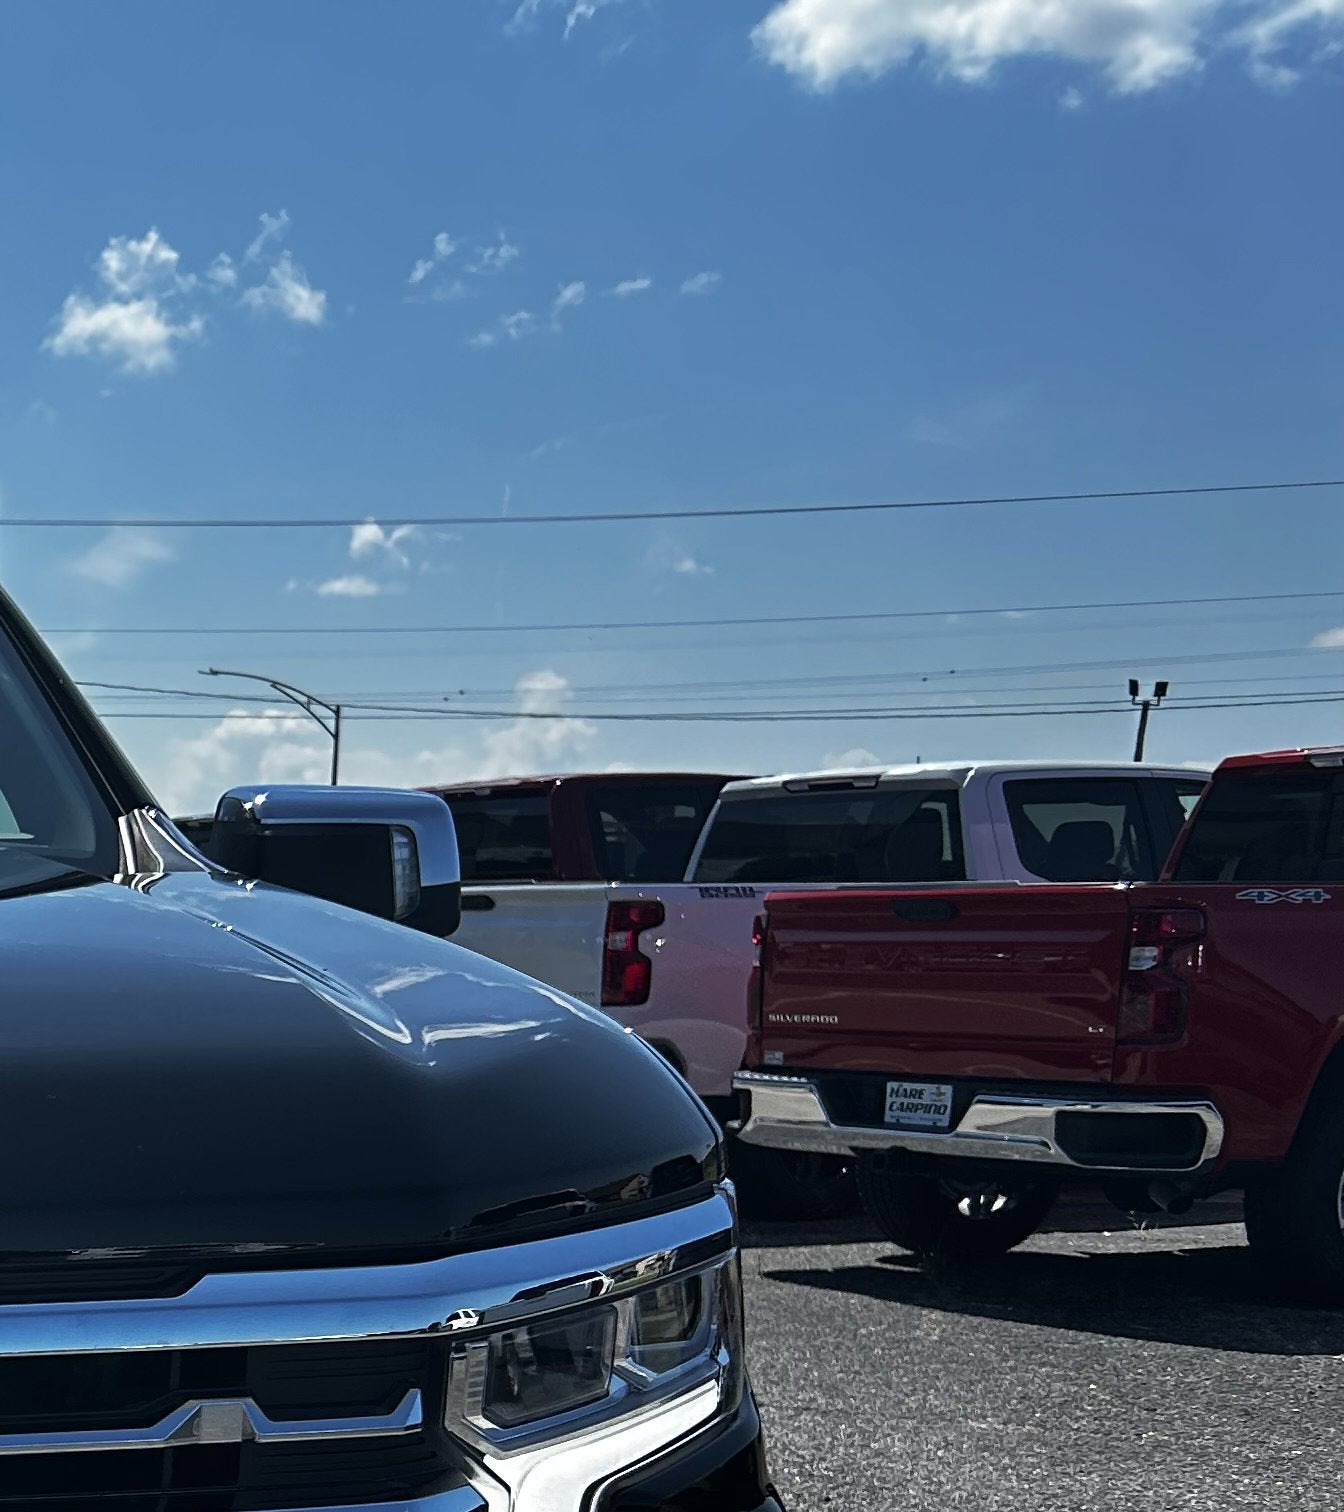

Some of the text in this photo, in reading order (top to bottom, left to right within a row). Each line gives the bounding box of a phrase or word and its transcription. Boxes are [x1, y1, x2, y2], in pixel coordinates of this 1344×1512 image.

[768, 1013, 839, 1025] SILVERADO
[889, 1086, 927, 1100] HARE
[888, 1100, 948, 1116] CARPINO
